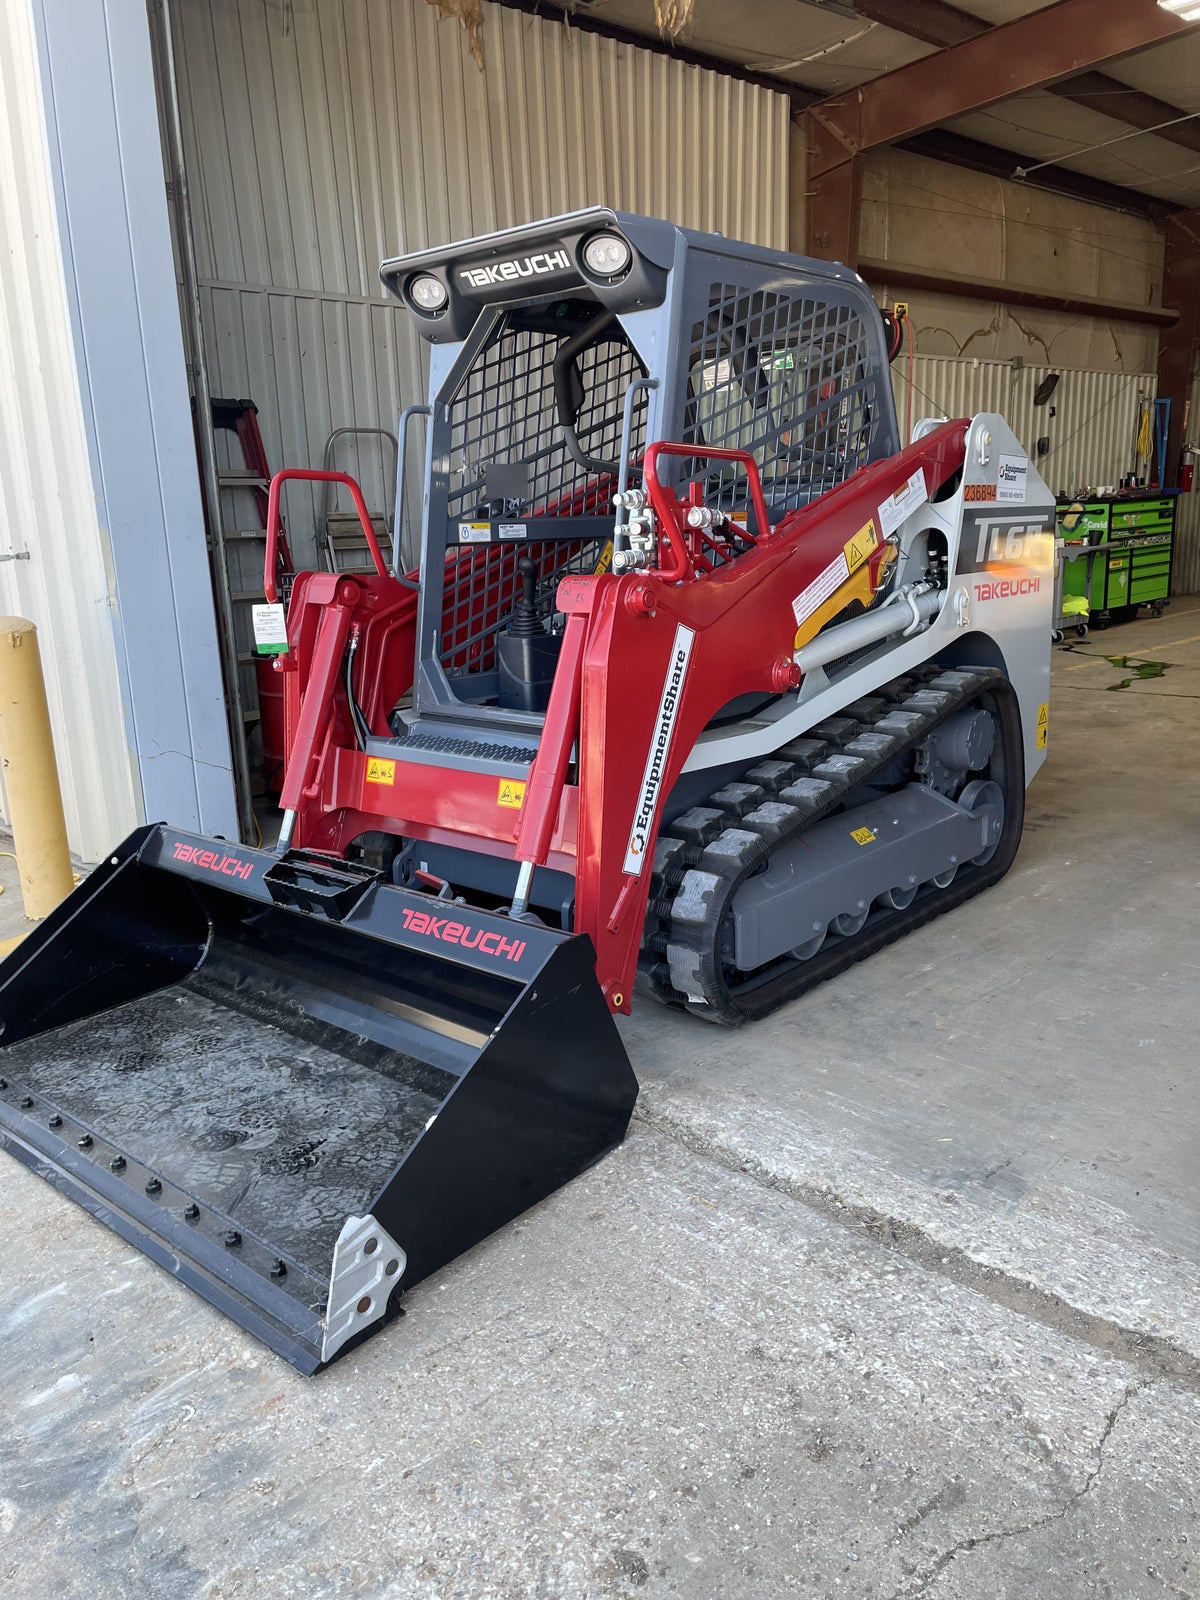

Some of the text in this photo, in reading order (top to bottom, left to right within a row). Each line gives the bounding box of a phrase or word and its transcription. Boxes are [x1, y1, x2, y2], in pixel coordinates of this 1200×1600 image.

[1005, 464, 1027, 475] Equipment
[1004, 473, 1017, 482] Share
[964, 484, 997, 501] 236894
[636, 649, 686, 831] EquipmentShare
